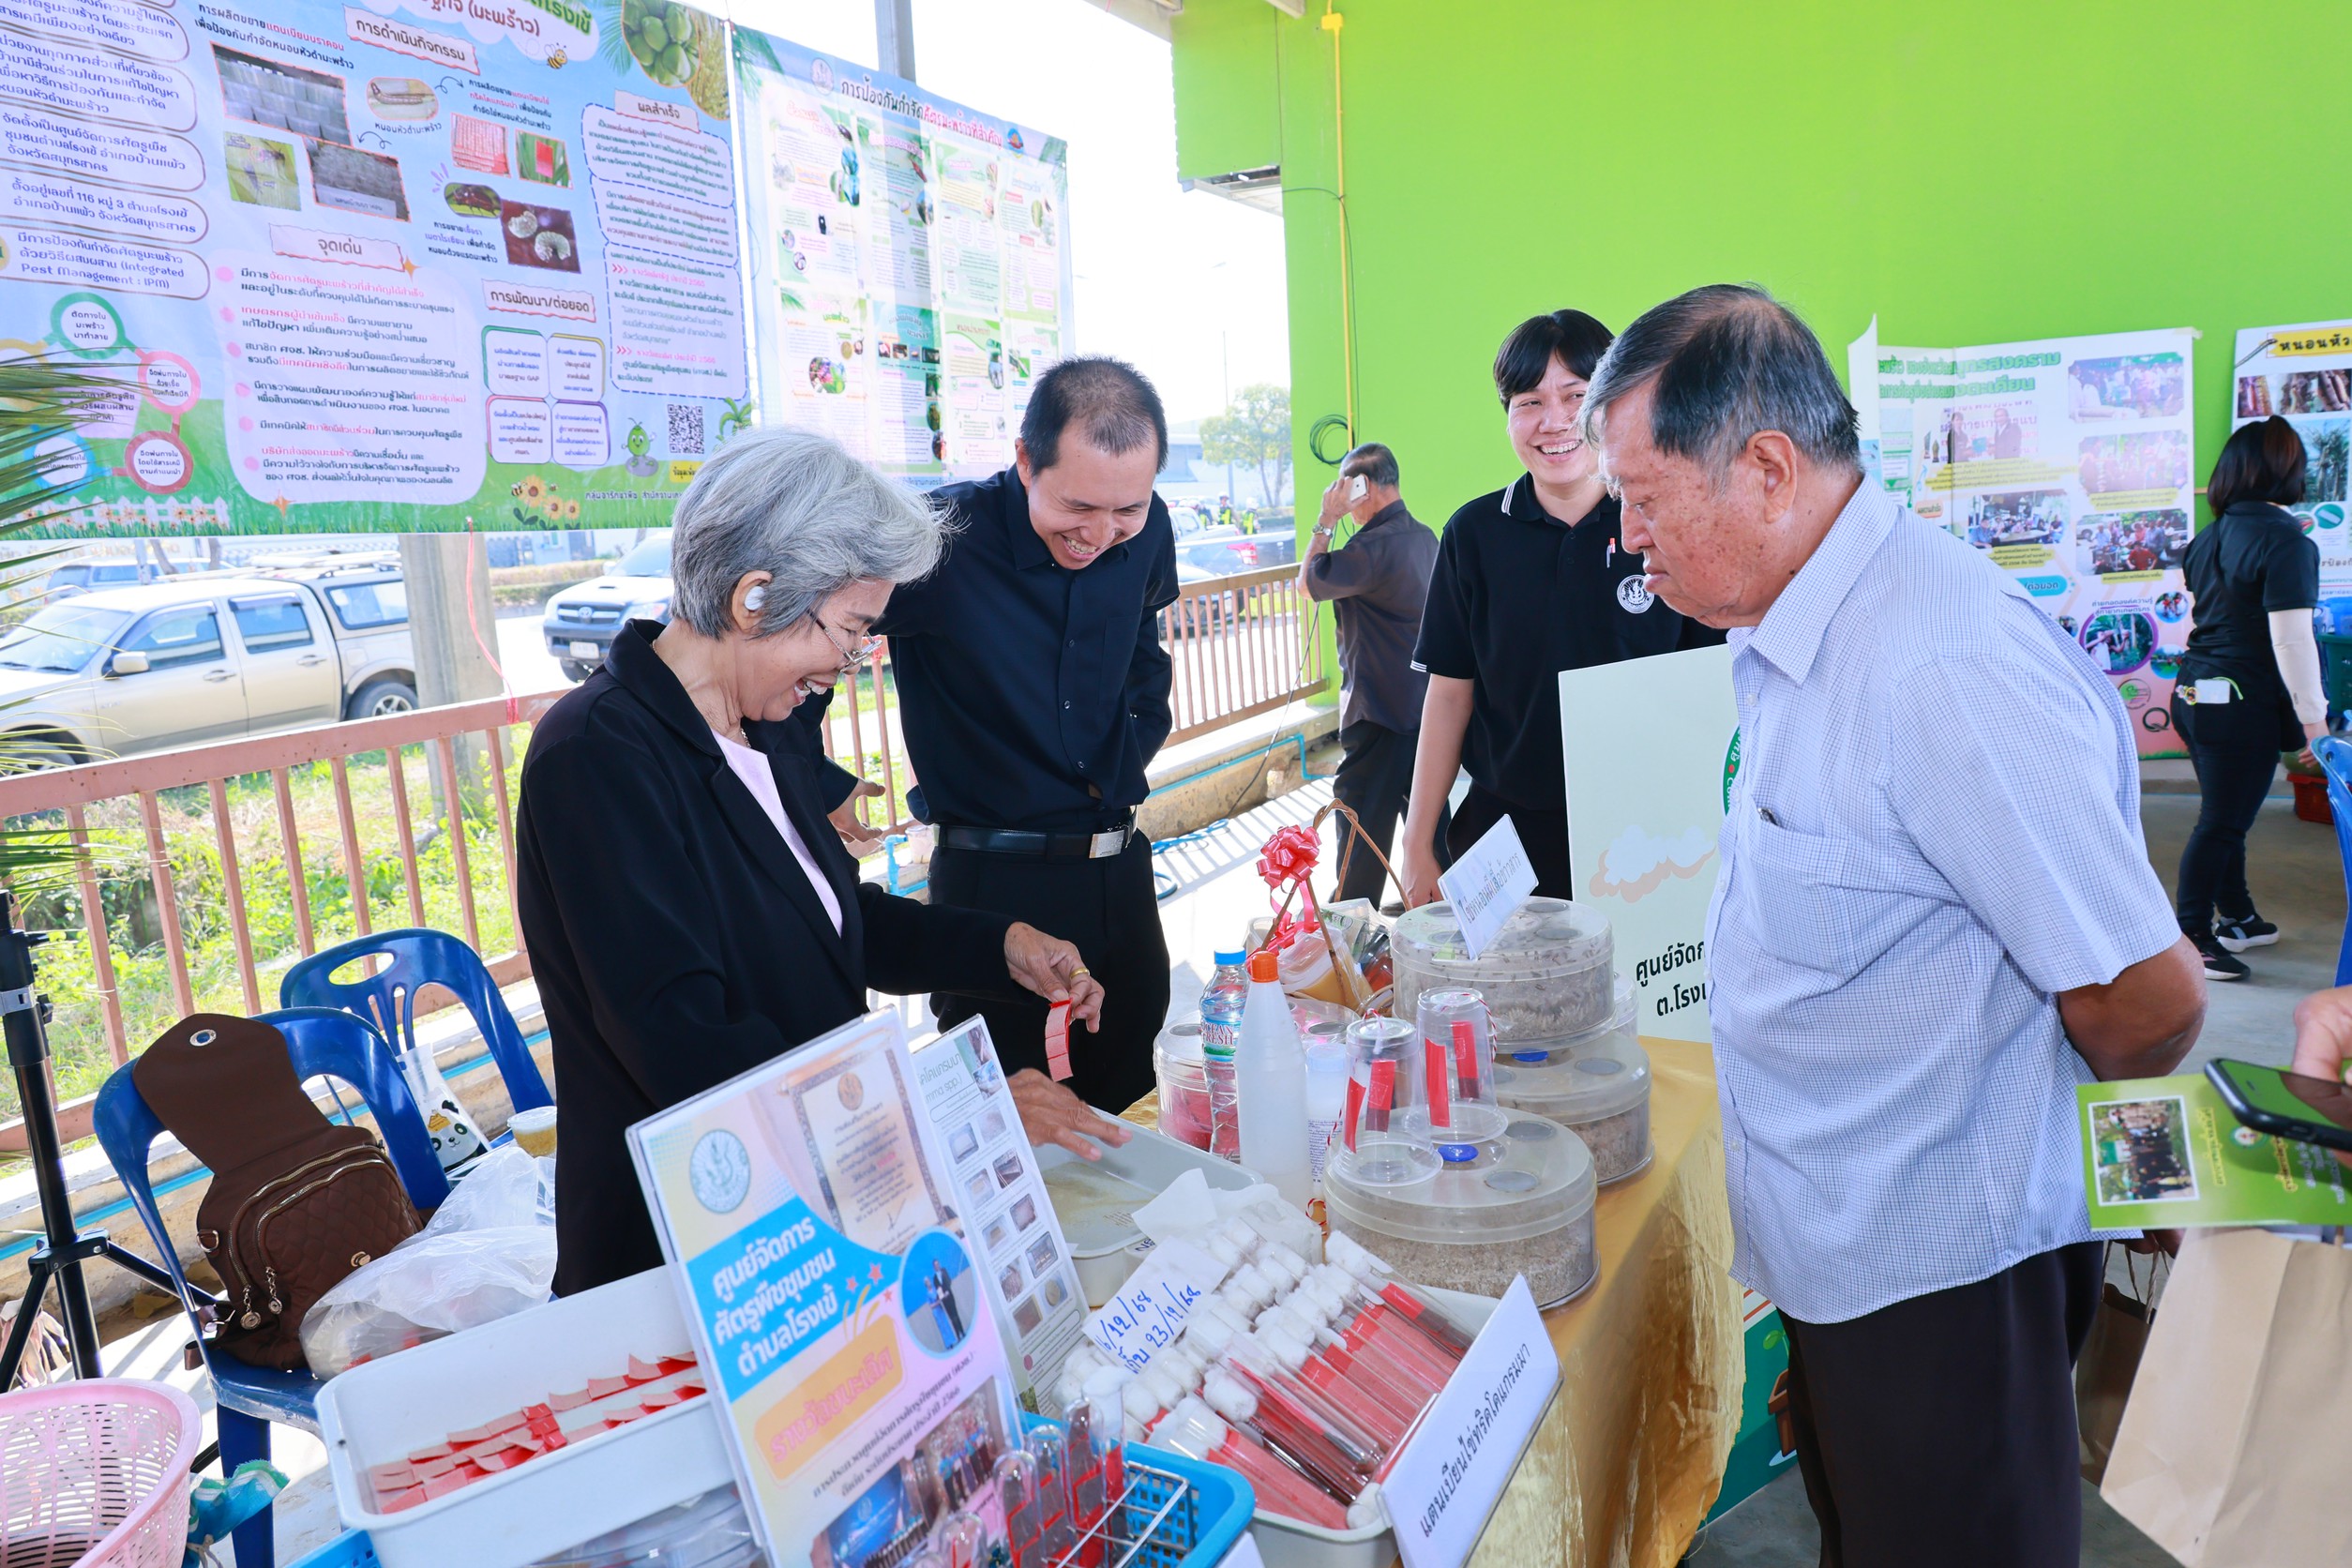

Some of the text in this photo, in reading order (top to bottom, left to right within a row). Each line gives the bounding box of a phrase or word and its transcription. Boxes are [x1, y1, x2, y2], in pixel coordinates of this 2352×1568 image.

[469, 5, 540, 37] (มะพร้าว)
[0, 34, 173, 83] น่วยงานทุกภาคส่วนที่เกี่ยวข้อง
[356, 19, 465, 62] การดำเนินกิจกรรม
[638, 102, 680, 119] ผลสำเร็จ
[841, 75, 1003, 150] การป้องกันกำจัดศัตรูมะพร้าวที่สำคัญ
[8, 143, 108, 172] จังหวัดสมุทรสาคร
[77, 192, 94, 203] 116
[116, 200, 125, 208] 3
[318, 237, 362, 255] จุดเด่น
[22, 264, 53, 275] Pest
[57, 267, 134, 284] Management
[490, 290, 590, 313] การพัฒนา/ต่อยอด
[1656, 983, 1707, 1017] ต.โรงเ
[713, 1217, 816, 1304] ศูนย์จัดการ
[714, 1247, 837, 1346] ศัตรูพืชชุมชน
[738, 1283, 838, 1377] ตำบลโรงเข้
[770, 1346, 895, 1463] รางวัลชนะเลิศ
[1419, 1343, 1531, 1538] แตนเบียนไข่ทริคโคแกรมมา
